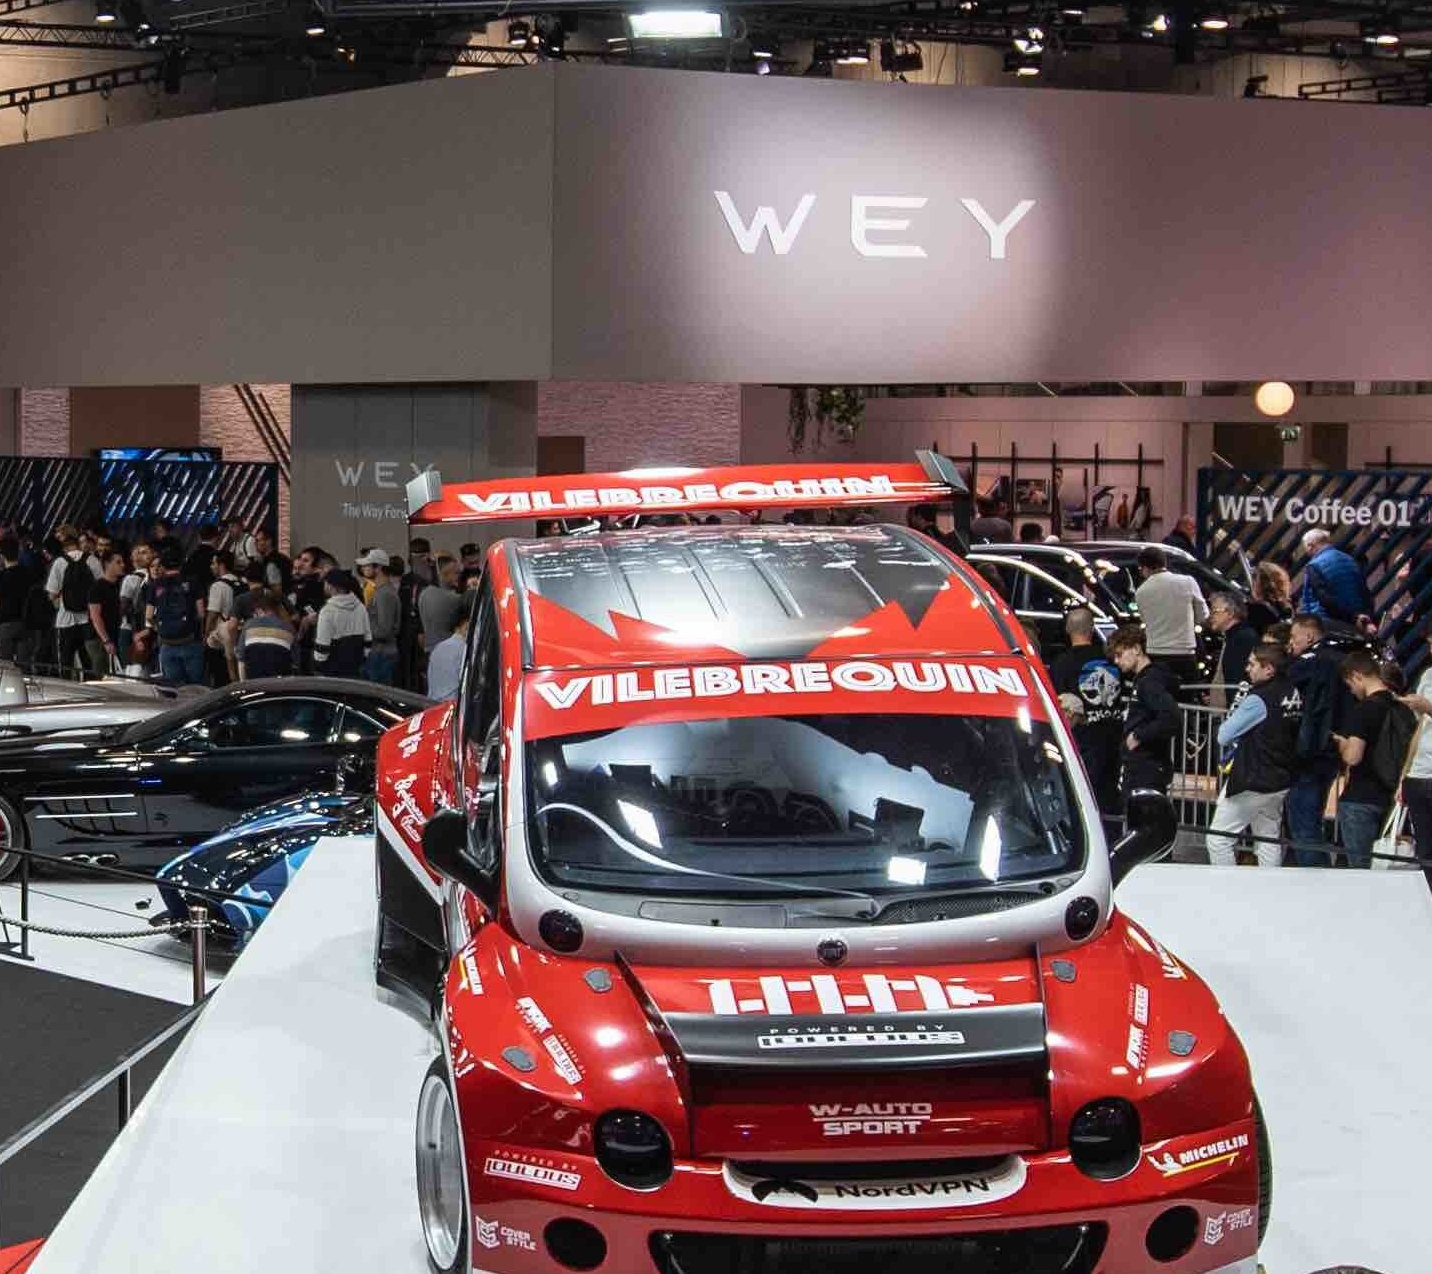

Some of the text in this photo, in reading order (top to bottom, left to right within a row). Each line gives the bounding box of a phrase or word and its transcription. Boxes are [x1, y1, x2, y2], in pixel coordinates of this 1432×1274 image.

[714, 190, 1035, 259] WEY
[457, 474, 895, 515] VILEBREQUIN
[1216, 493, 1412, 527] WEY Coffee 01
[533, 662, 1030, 711] VILEBREQUIN
[769, 1023, 945, 1035] POWERED BY
[808, 1102, 932, 1117] W-AUTO
[823, 1120, 922, 1137] SPORT
[1179, 1134, 1250, 1165] MICHELIN
[833, 1177, 990, 1200] NordVPN
[500, 1226, 532, 1241] COVER
[505, 1236, 538, 1252] STYLE
